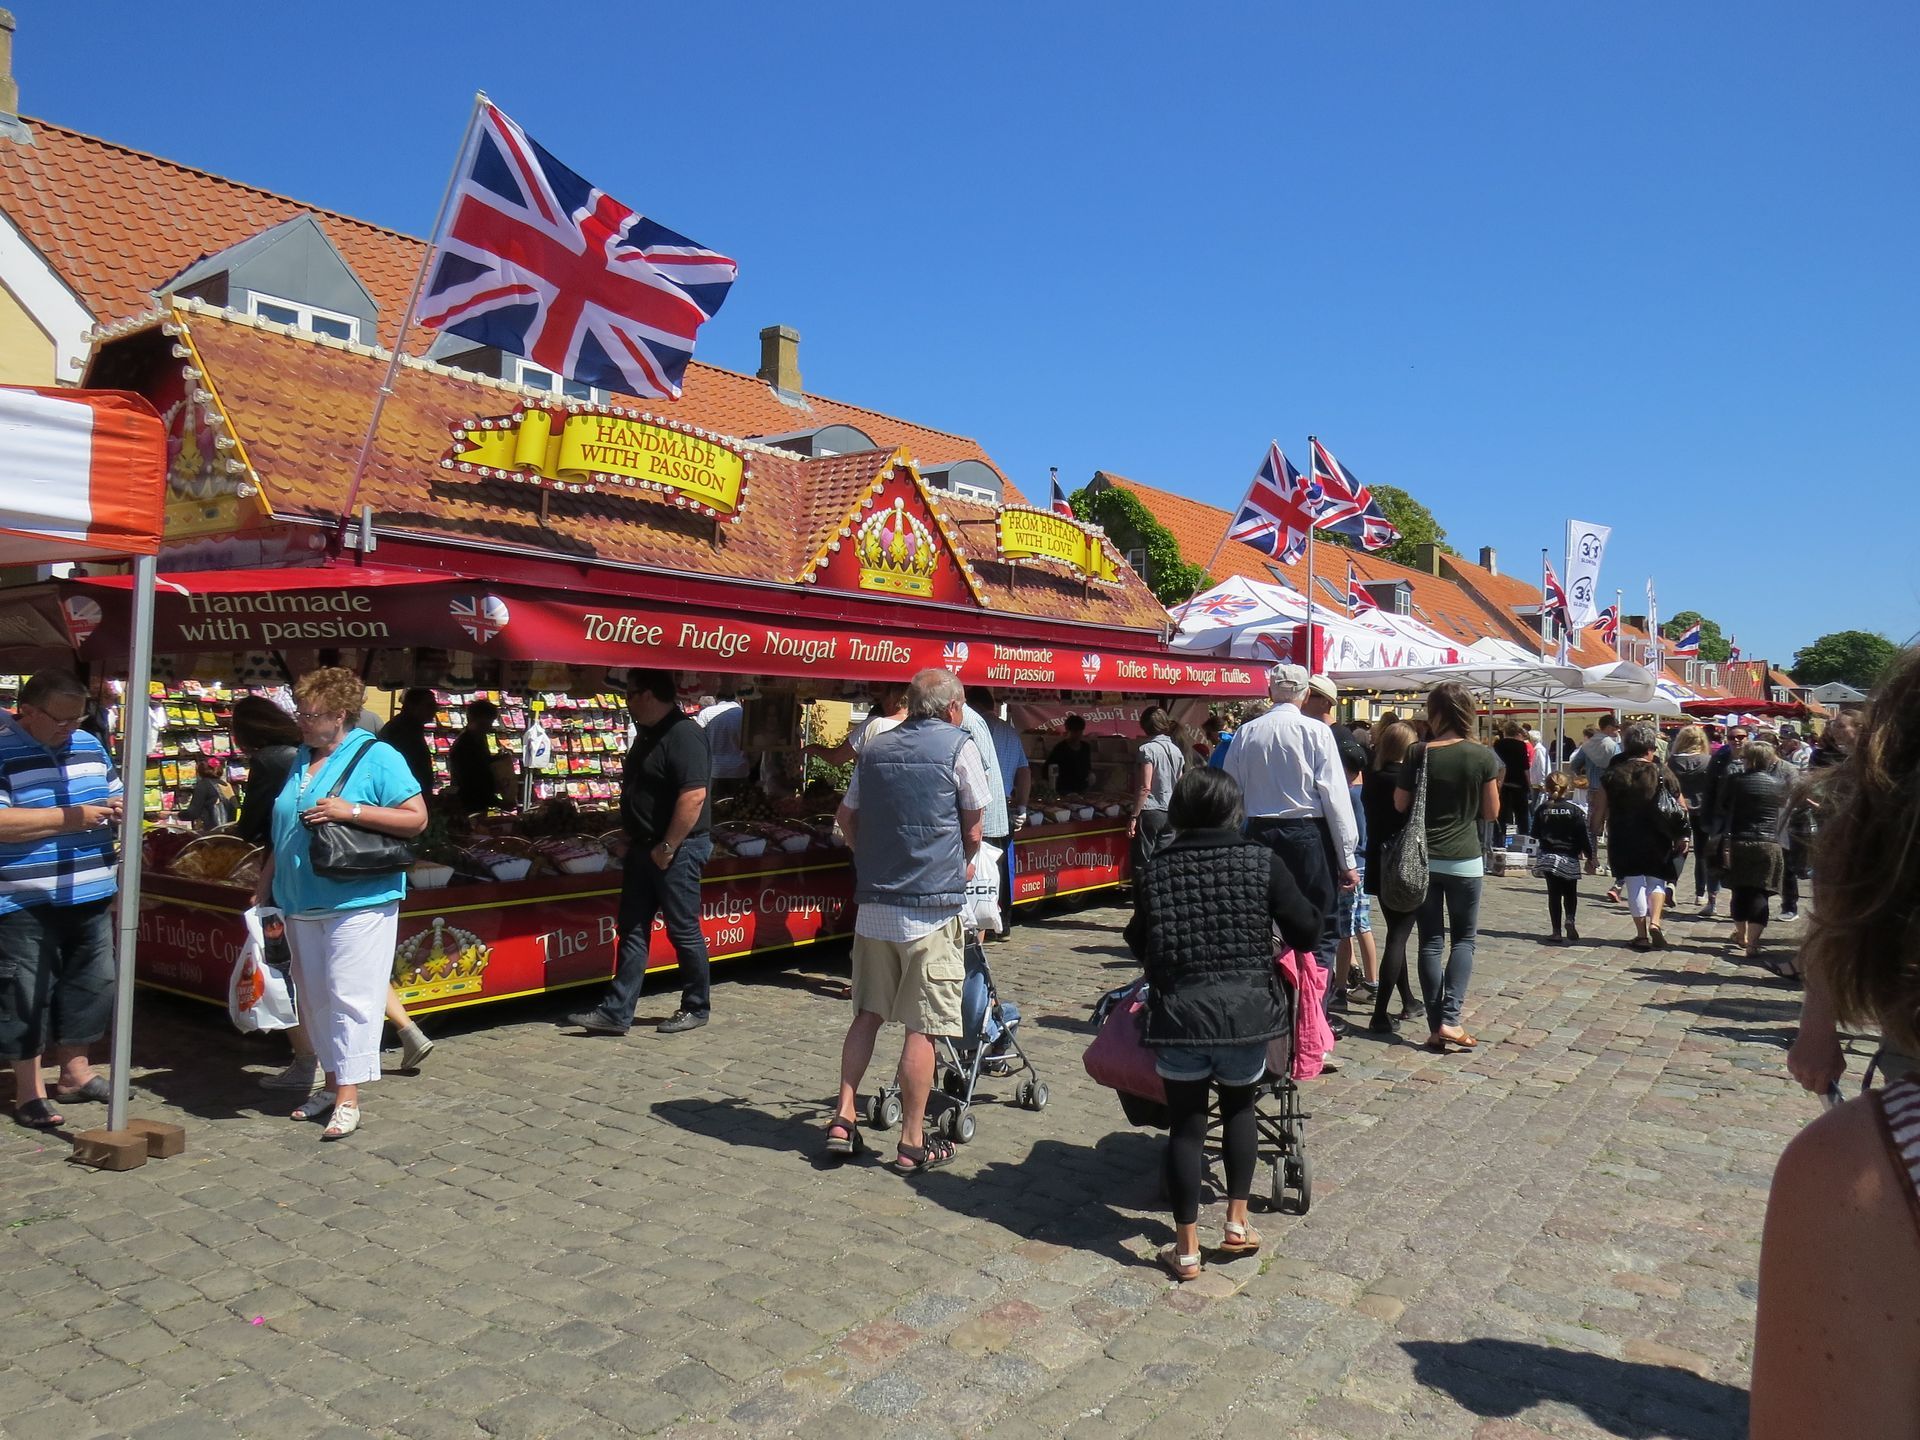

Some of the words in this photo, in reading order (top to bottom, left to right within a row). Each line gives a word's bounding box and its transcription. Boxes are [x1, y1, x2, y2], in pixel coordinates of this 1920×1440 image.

[595, 424, 717, 470] HANDMADE
[580, 443, 640, 469] WITH
[648, 455, 726, 493] PASSION
[1008, 516, 1039, 532] FROM
[1041, 521, 1080, 545] BRITAIN
[1015, 532, 1043, 549] WITH
[1047, 537, 1073, 557] LOVE
[187, 590, 373, 614] Handmade
[179, 617, 251, 642] with
[259, 616, 390, 646] passion
[582, 613, 664, 647] Toffee
[677, 622, 752, 659] Fudge
[762, 630, 838, 664] Nougat
[848, 637, 912, 664] Truffles
[993, 643, 1053, 664] Handmade
[987, 663, 1010, 680] with
[1013, 666, 1055, 685] passion
[1116, 659, 1148, 680] Toffee
[1153, 663, 1182, 686] Fudge
[1186, 665, 1216, 687] Nougat
[1220, 667, 1251, 684] Truffles
[1026, 848, 1063, 873] Fudge
[1065, 846, 1116, 873] Company
[1021, 879, 1041, 893] since
[154, 914, 207, 959] Fudge
[535, 927, 588, 964] The
[701, 891, 753, 924] udge
[759, 887, 847, 921] Company
[715, 926, 745, 948] 1980
